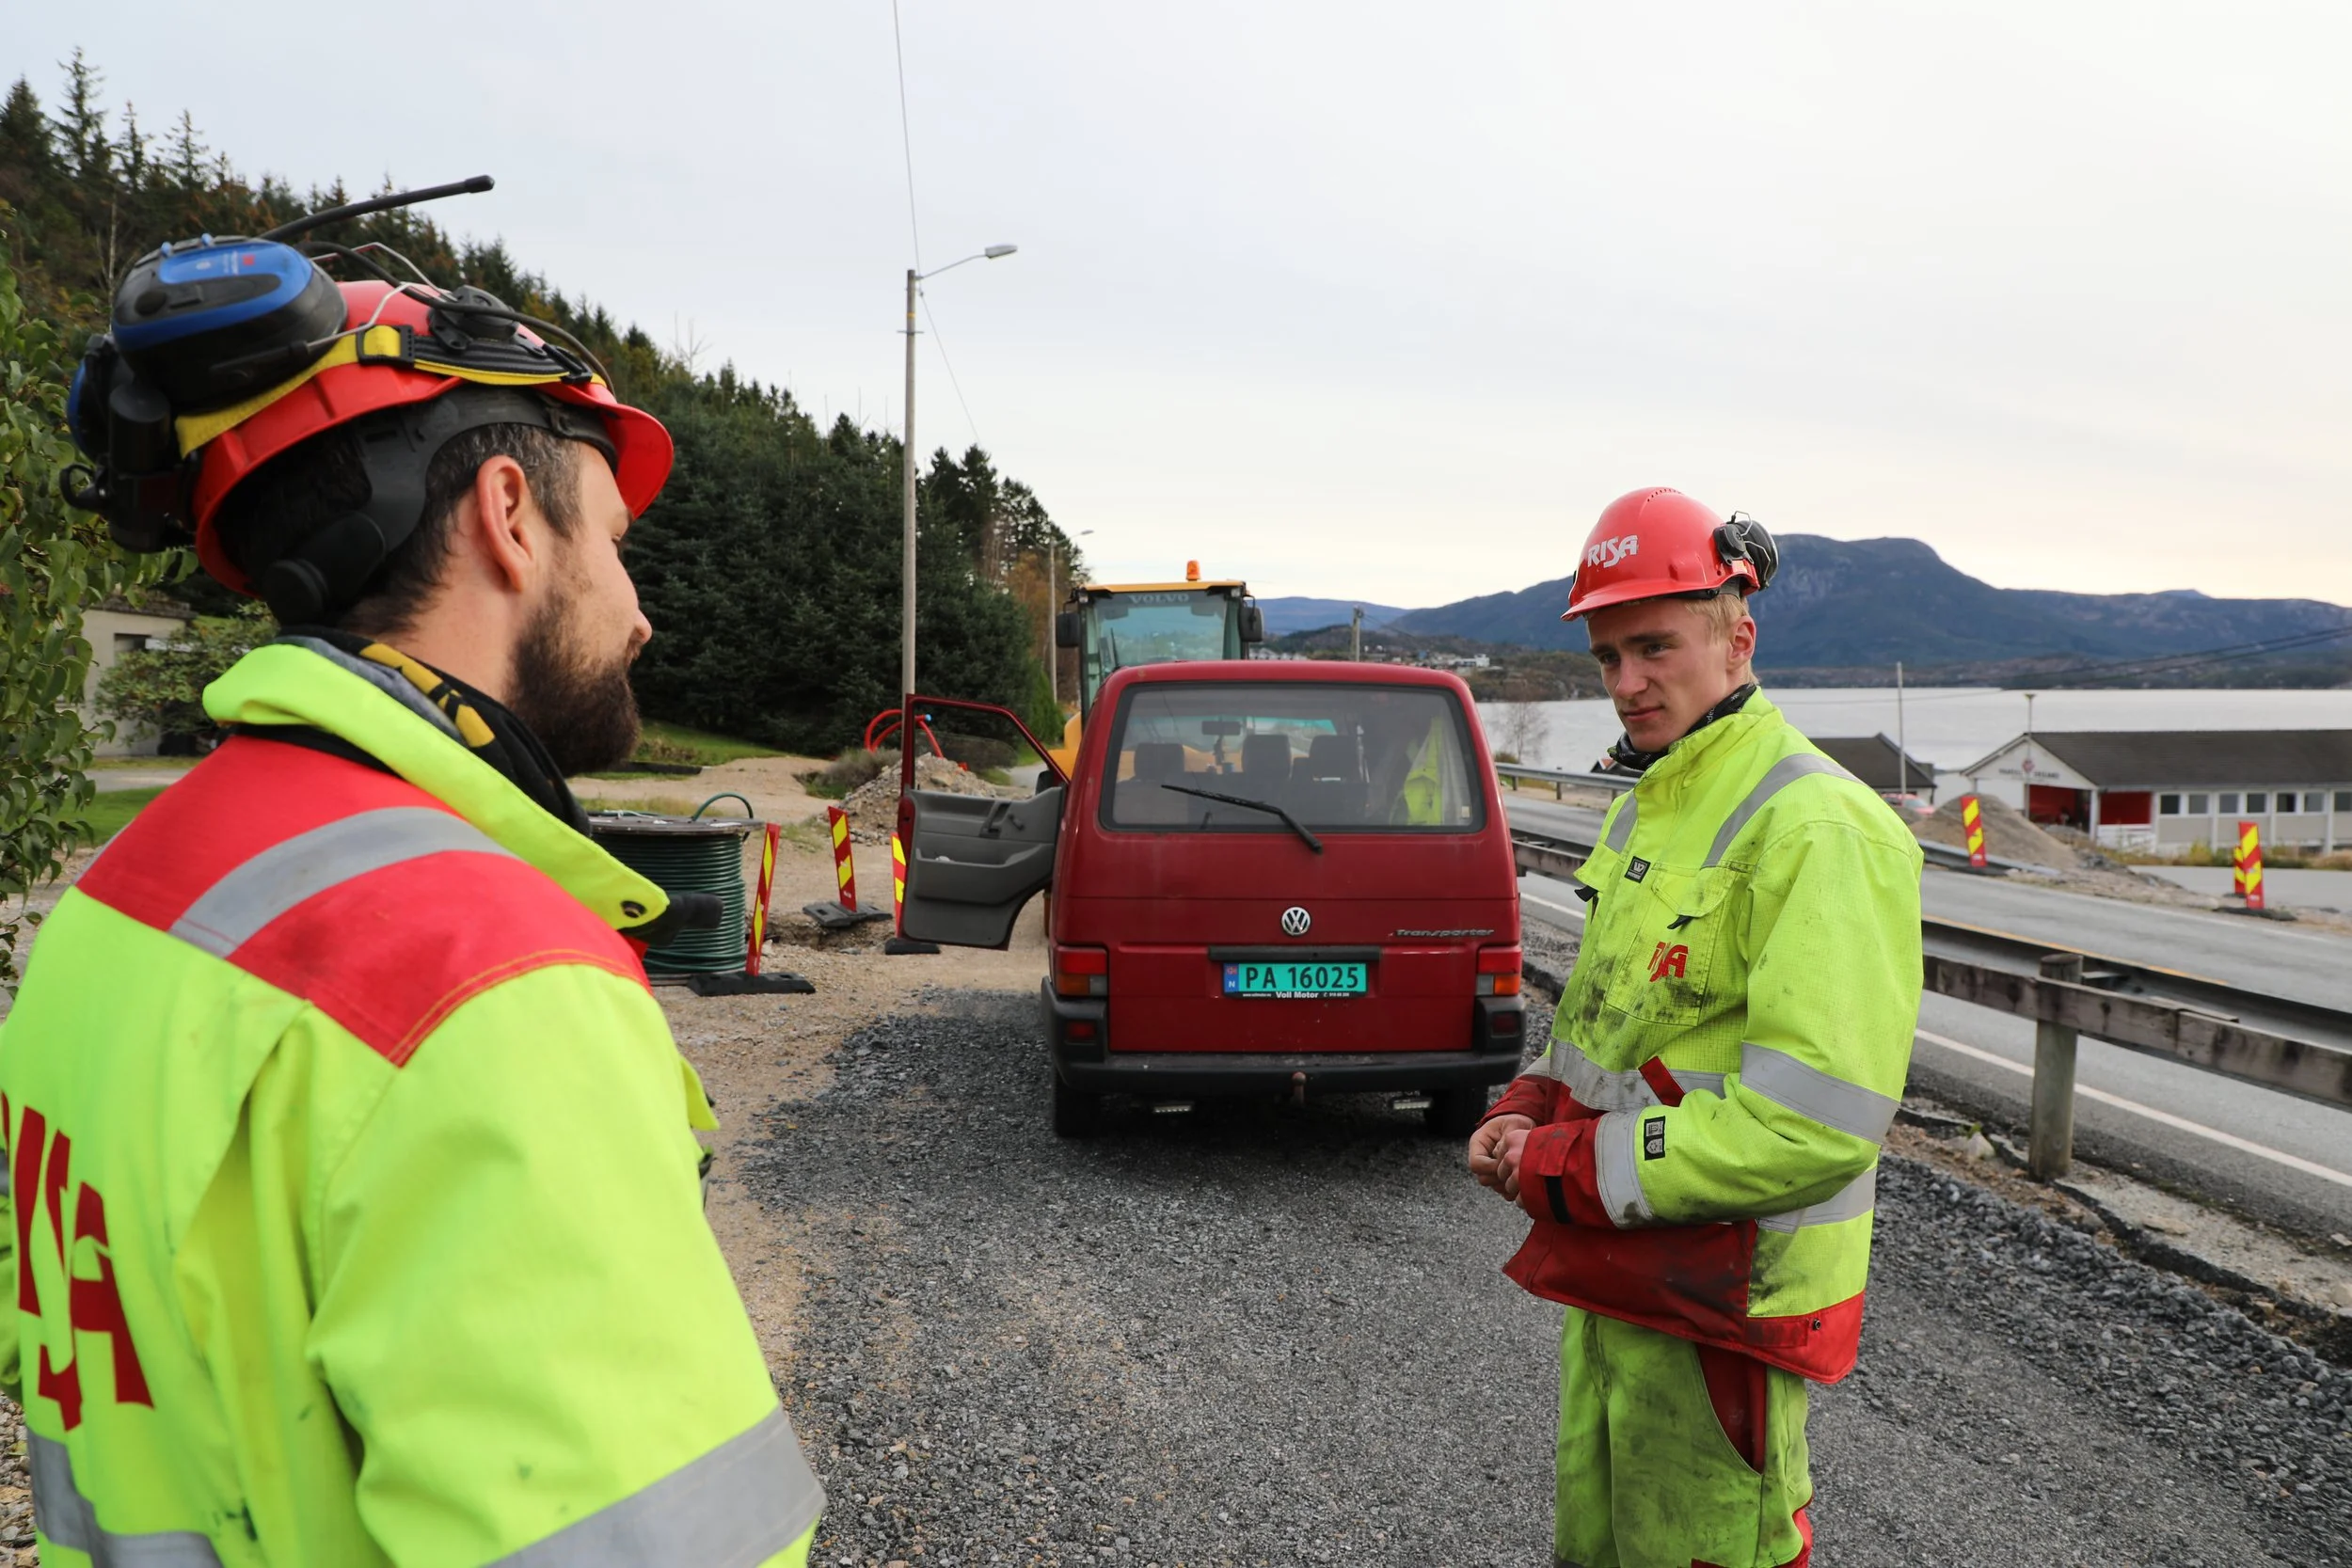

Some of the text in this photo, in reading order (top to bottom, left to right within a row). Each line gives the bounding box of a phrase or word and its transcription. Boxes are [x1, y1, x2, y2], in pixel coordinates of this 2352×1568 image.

[1587, 534, 1640, 568] RISA
[1128, 594, 1190, 604] VOLVO
[1396, 929, 1495, 938] Transporter
[1246, 966, 1359, 989] PA 16025
[0, 1089, 155, 1433] ISA
